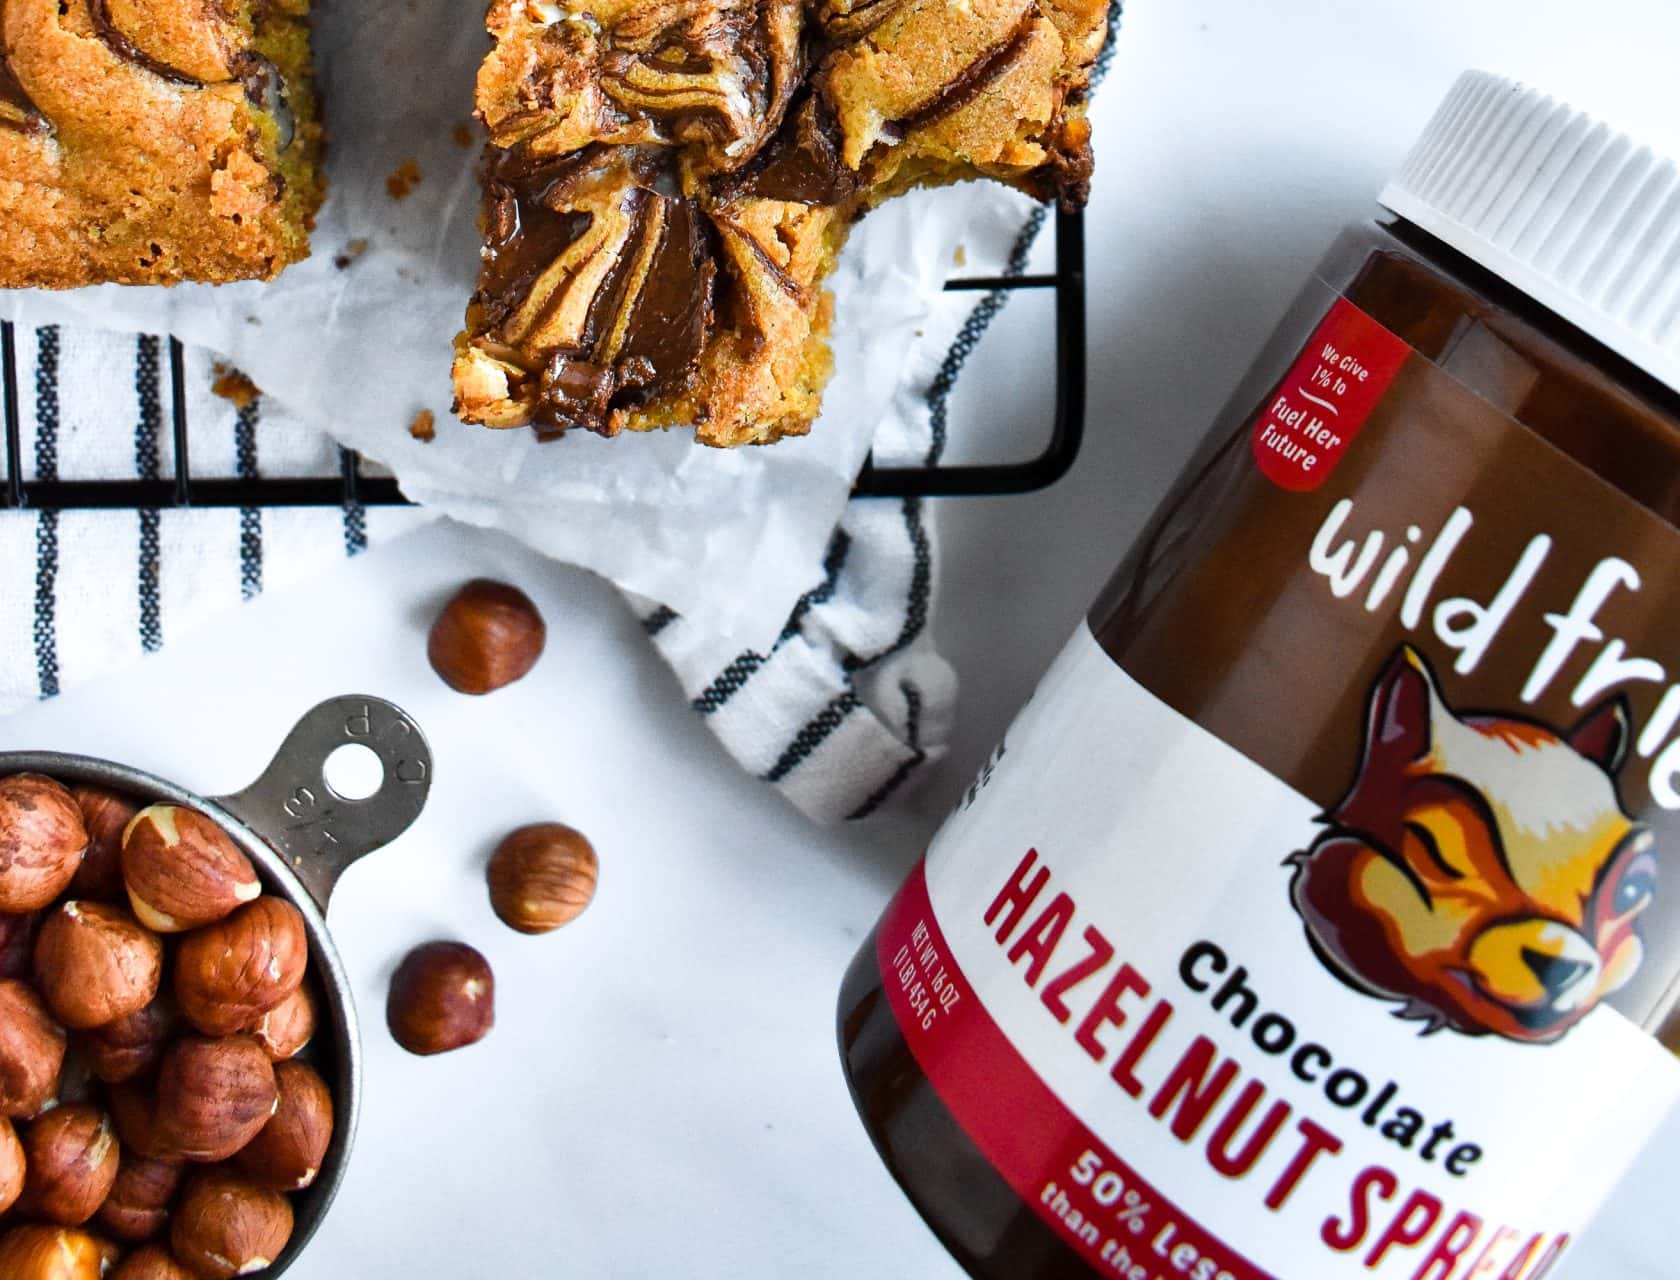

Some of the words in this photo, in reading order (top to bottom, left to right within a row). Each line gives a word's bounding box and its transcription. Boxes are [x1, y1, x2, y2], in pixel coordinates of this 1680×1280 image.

[1311, 364, 1334, 388] 1%
[1332, 376, 1347, 395] to
[1321, 343, 1339, 365] We
[1339, 355, 1369, 382] Give
[1260, 423, 1317, 471] Future
[1271, 396, 1308, 430] Fuel
[1303, 417, 1341, 450] Her
[1309, 498, 1552, 676] wild
[911, 919, 930, 952] NET
[931, 966, 948, 993] 16
[940, 983, 960, 1015] OZ
[908, 981, 930, 1017] 454
[922, 1008, 936, 1031] G
[983, 847, 1344, 1212] HAZELNUT
[1069, 1148, 1151, 1234] 50%
[1040, 1181, 1100, 1246] than
[1100, 1238, 1148, 1280] the
